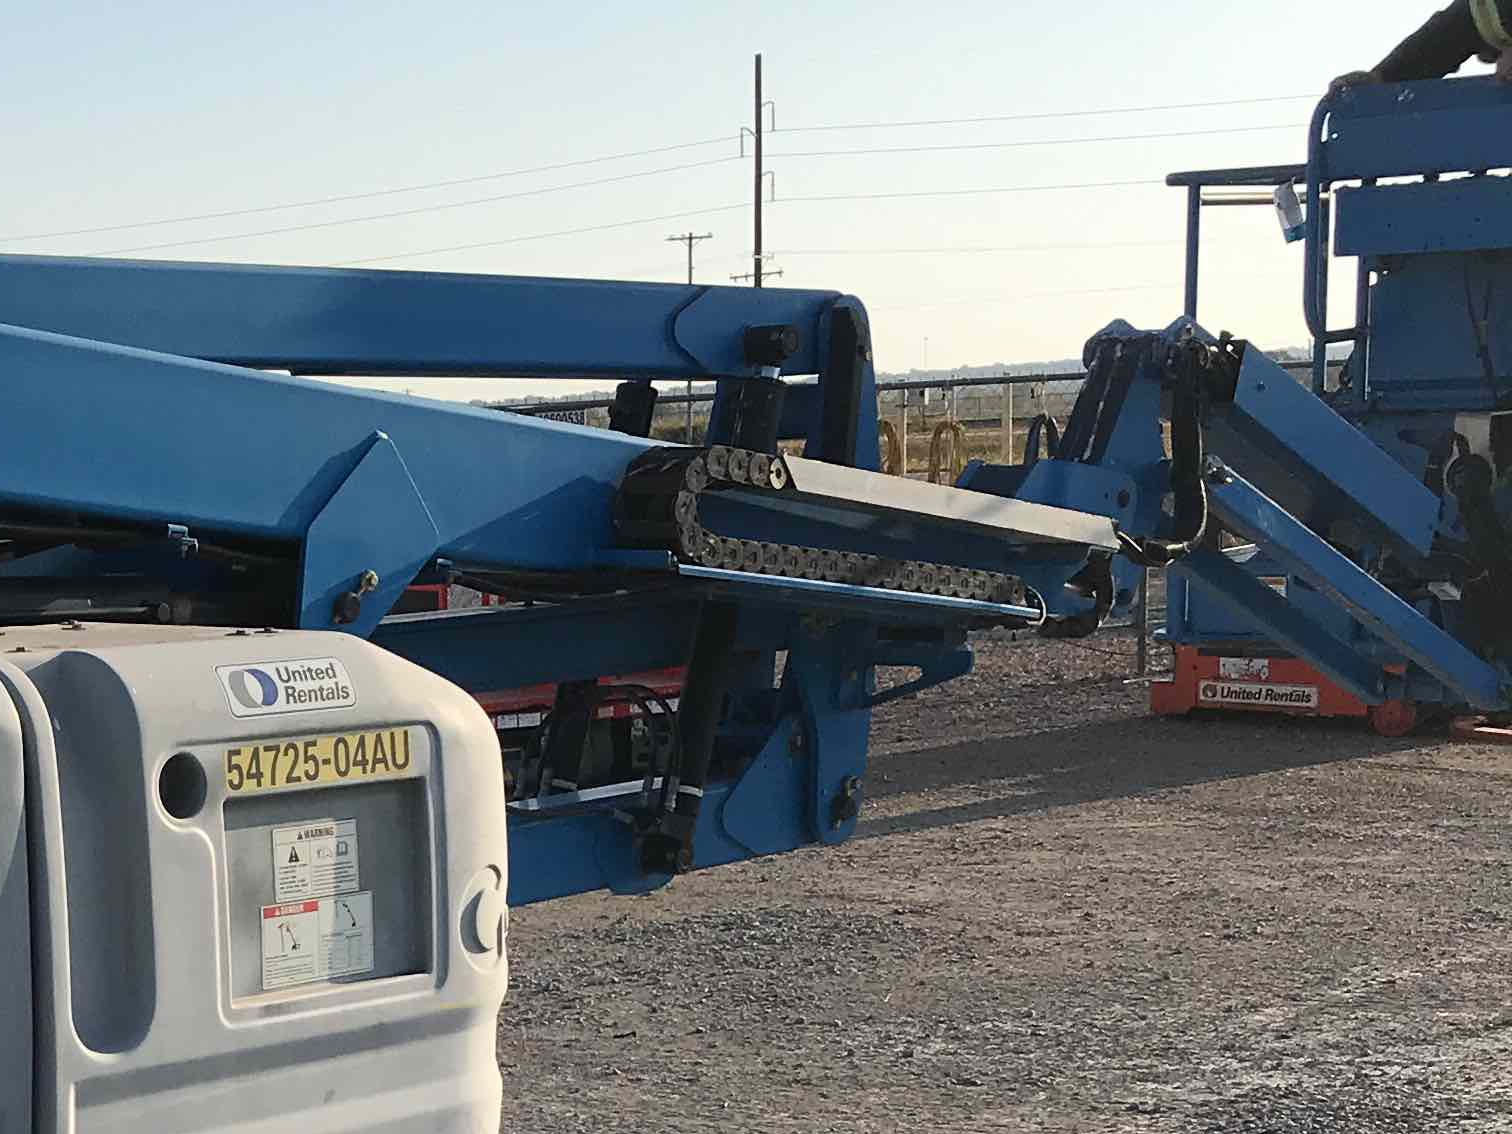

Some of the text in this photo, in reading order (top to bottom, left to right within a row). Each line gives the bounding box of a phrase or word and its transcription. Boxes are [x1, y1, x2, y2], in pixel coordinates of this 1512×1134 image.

[276, 663, 337, 684] United
[285, 682, 350, 704] Rentals
[1221, 685, 1312, 703] United Rentals
[227, 730, 410, 791] 54725-04AU
